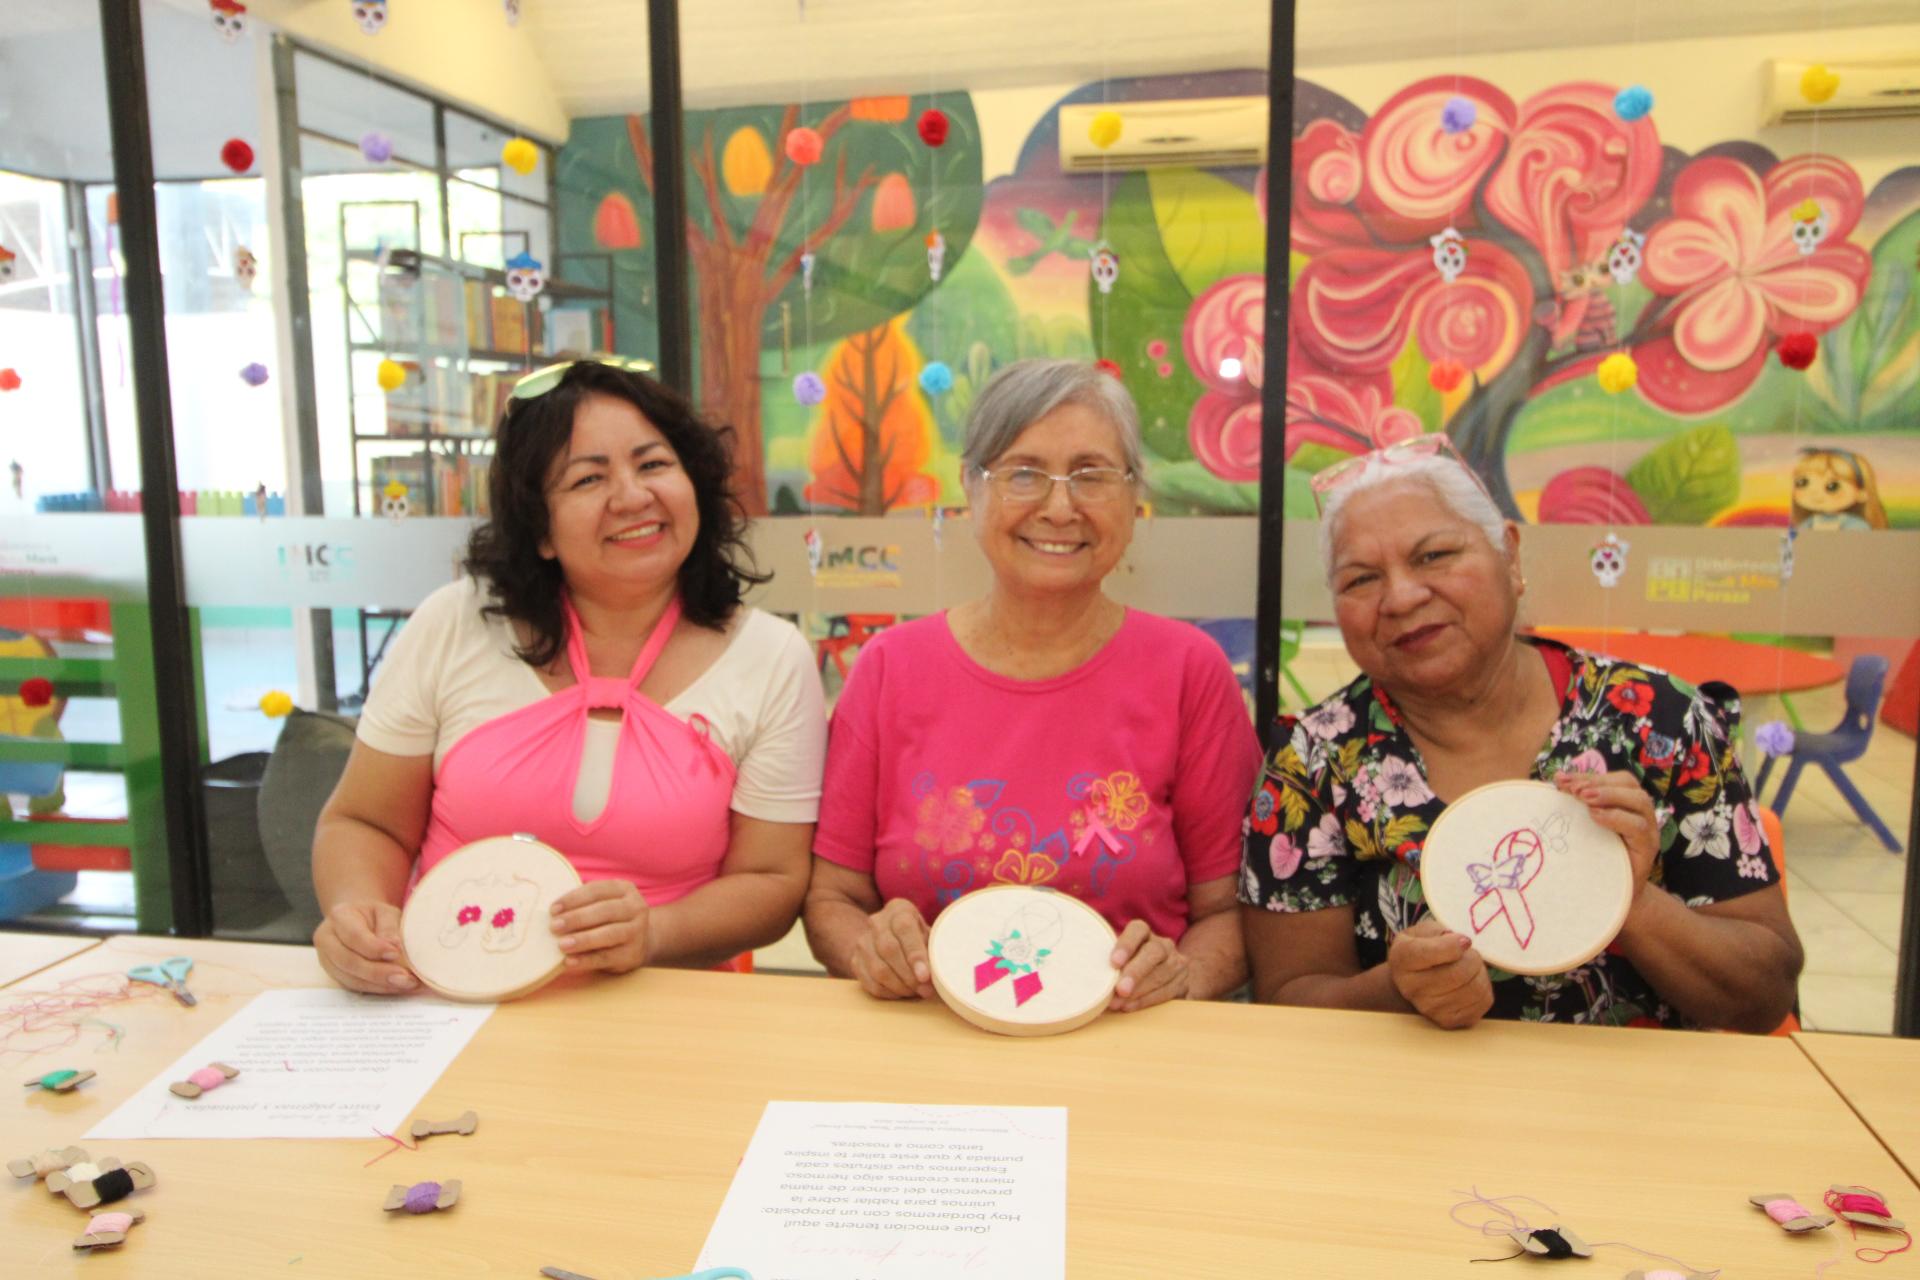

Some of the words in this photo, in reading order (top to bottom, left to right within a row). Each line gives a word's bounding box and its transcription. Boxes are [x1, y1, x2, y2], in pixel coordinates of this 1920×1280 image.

[897, 1163, 924, 1171] que
[854, 1198, 900, 1206] hablar
[904, 1198, 937, 1206] para
[895, 1211, 985, 1220] bordaremos
[991, 1212, 1021, 1222] Hoy
